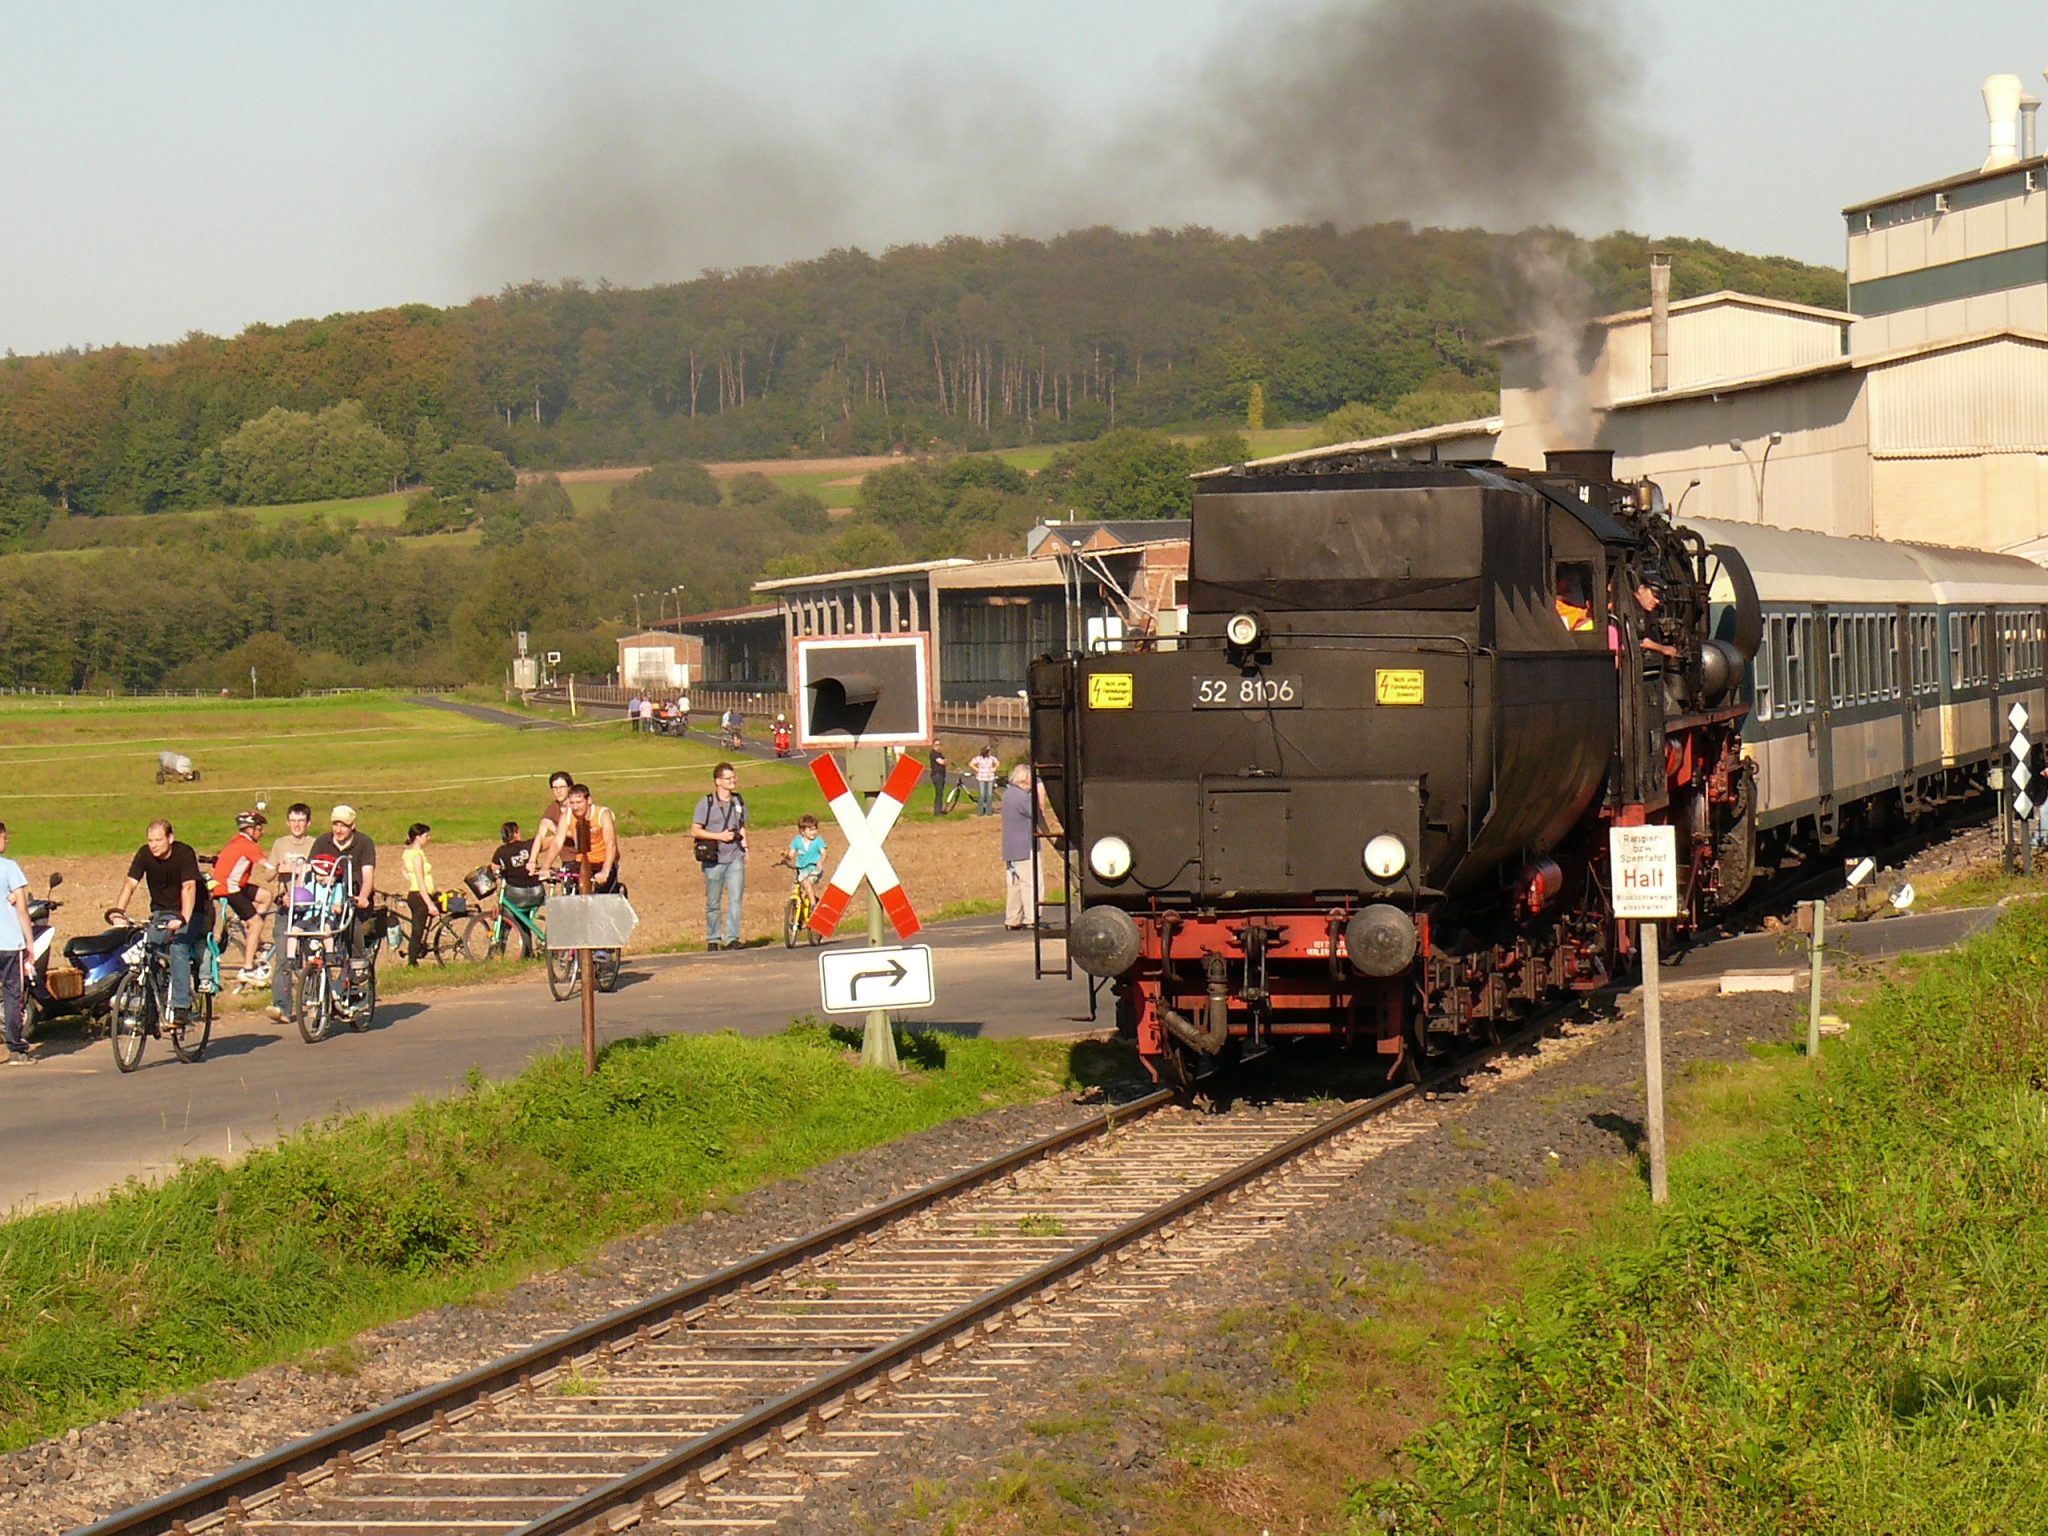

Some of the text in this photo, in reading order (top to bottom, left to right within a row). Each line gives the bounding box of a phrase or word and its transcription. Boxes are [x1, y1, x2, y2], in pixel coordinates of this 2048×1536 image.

[1198, 680, 1294, 702] 52 8106
[1624, 868, 1663, 888] Halt
